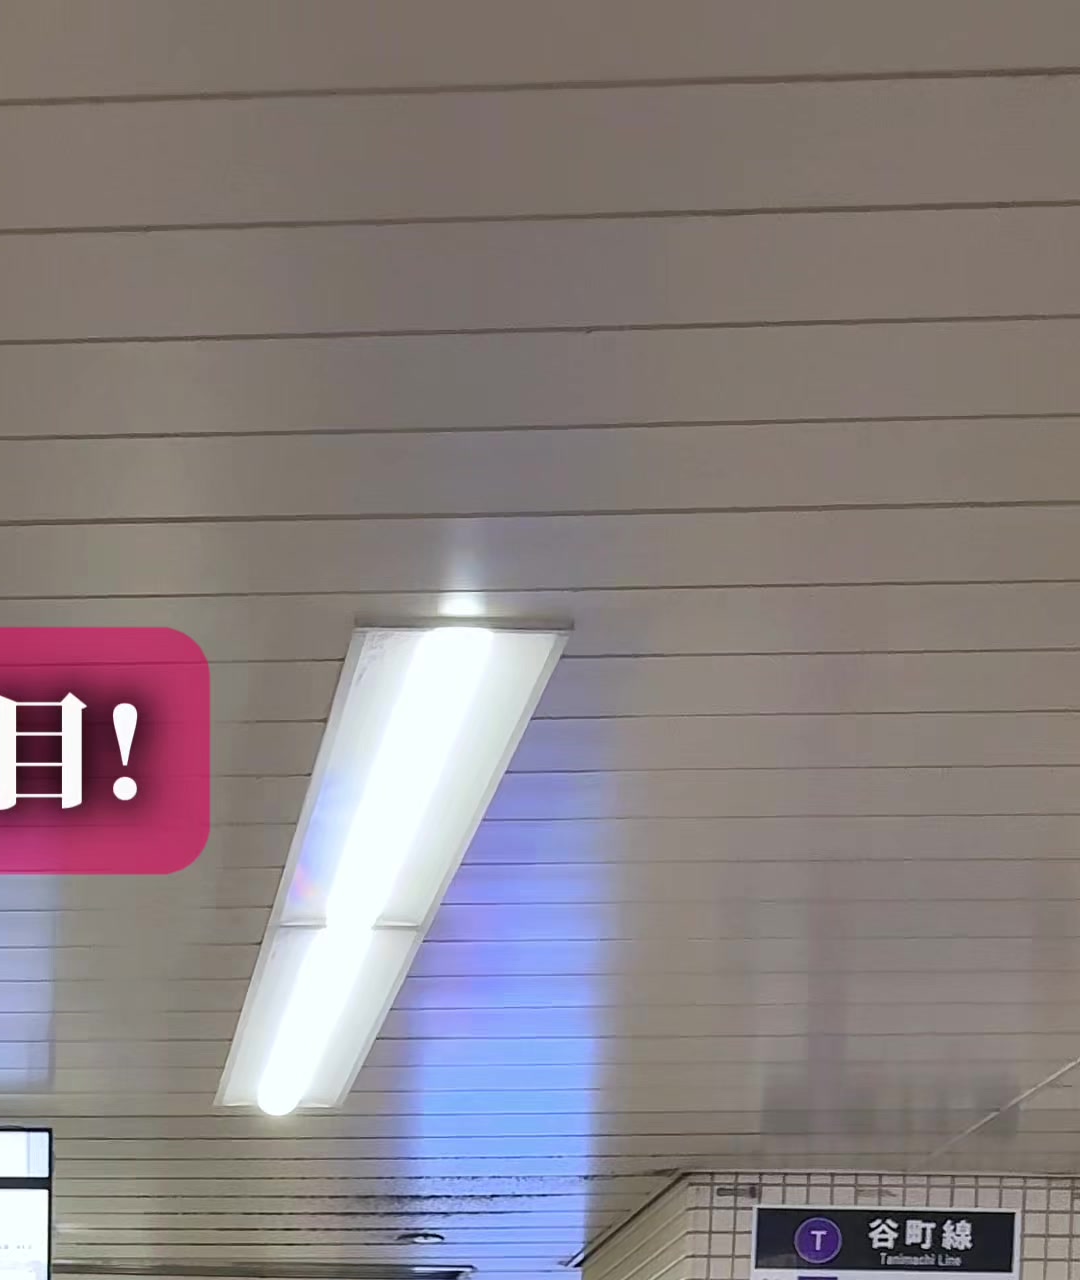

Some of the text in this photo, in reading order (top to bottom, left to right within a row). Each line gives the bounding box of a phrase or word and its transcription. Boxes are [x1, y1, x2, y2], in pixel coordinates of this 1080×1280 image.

[810, 1230, 827, 1251] T
[868, 1218, 973, 1250] 谷町線
[880, 1252, 962, 1266] Tanimachi Line
